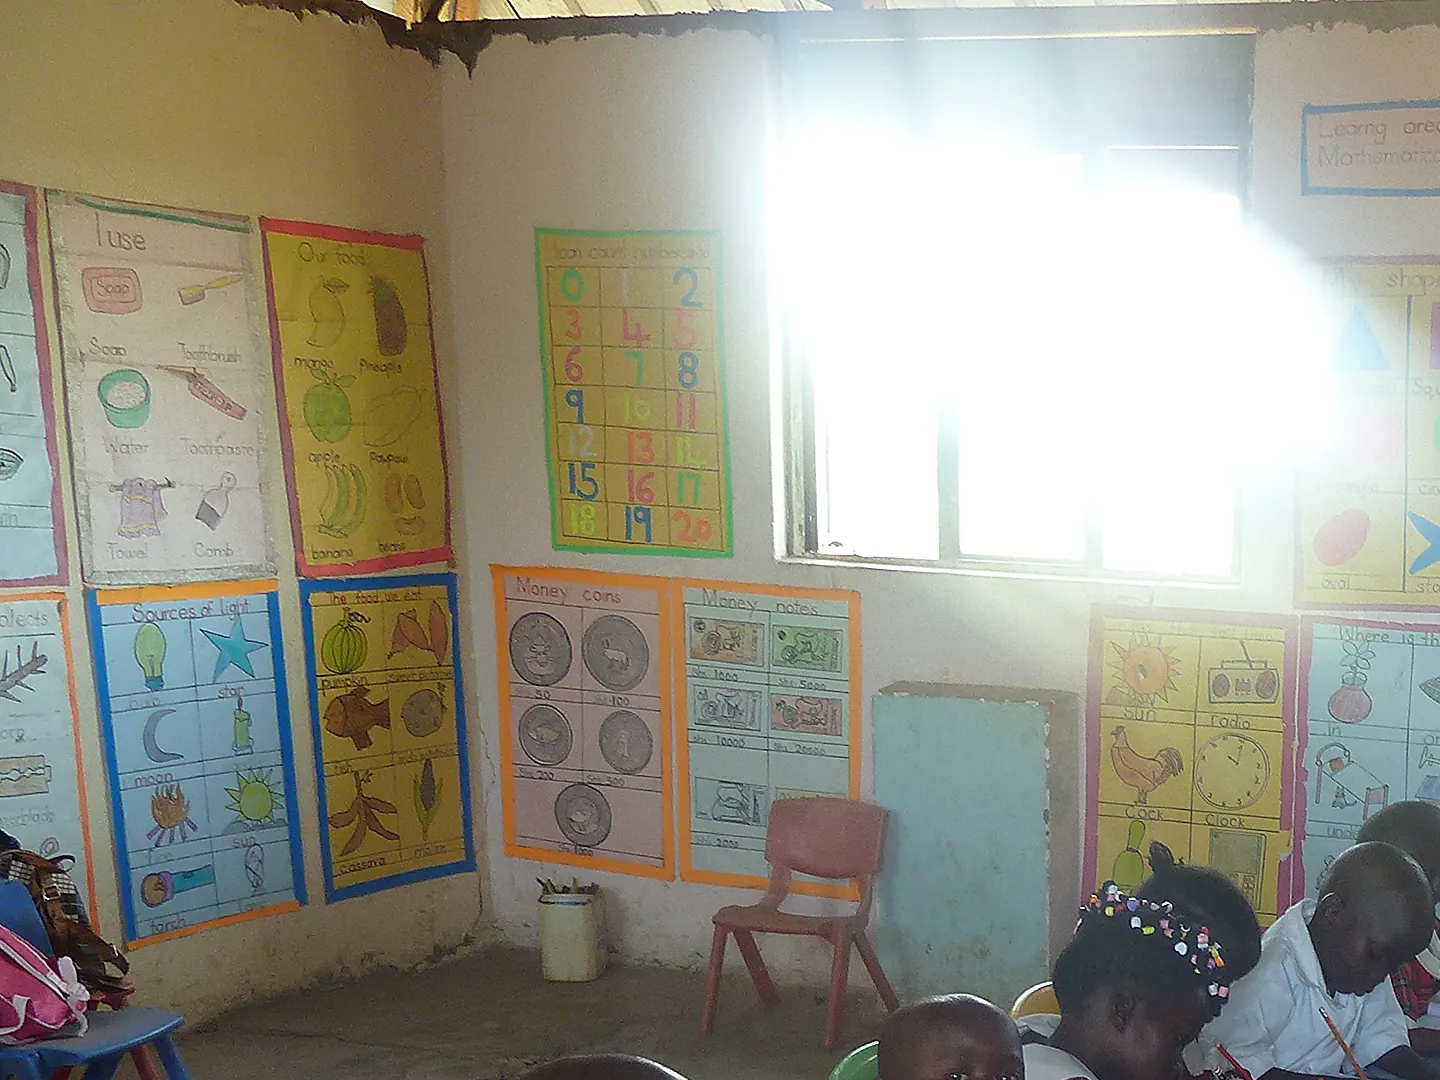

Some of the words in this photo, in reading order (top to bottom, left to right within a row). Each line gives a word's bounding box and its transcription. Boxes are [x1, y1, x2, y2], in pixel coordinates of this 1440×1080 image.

[106, 229, 146, 252] use
[560, 267, 585, 302] 0
[673, 267, 702, 308] 2
[565, 308, 582, 340] 3
[622, 308, 652, 349] 4
[674, 309, 698, 350] 5
[565, 345, 584, 382] 6
[626, 350, 645, 386] 7
[677, 351, 698, 389] 8
[564, 388, 585, 424] 9
[623, 391, 651, 425] 10
[675, 391, 697, 430] 11
[627, 431, 656, 464] 13
[568, 462, 600, 500] 15
[628, 469, 656, 504] 16
[678, 472, 703, 505] 17
[569, 503, 597, 536] 18
[624, 505, 652, 544] 19
[673, 511, 712, 542] 20
[194, 542, 235, 558] Comb
[516, 576, 568, 605] Money
[582, 588, 624, 604] coins
[1321, 575, 1350, 590] oval
[131, 604, 196, 623] Sources
[200, 602, 214, 618] of
[220, 599, 251, 622] light
[702, 588, 759, 617] Money
[776, 600, 819, 615] notes
[1338, 625, 1390, 643] Where
[1402, 633, 1415, 645] is
[715, 670, 739, 682] 1000
[1123, 706, 1157, 722] sun
[1211, 713, 1251, 730] radio
[1327, 725, 1342, 737] in
[1125, 806, 1165, 821] Cock
[1205, 813, 1246, 829] Clock
